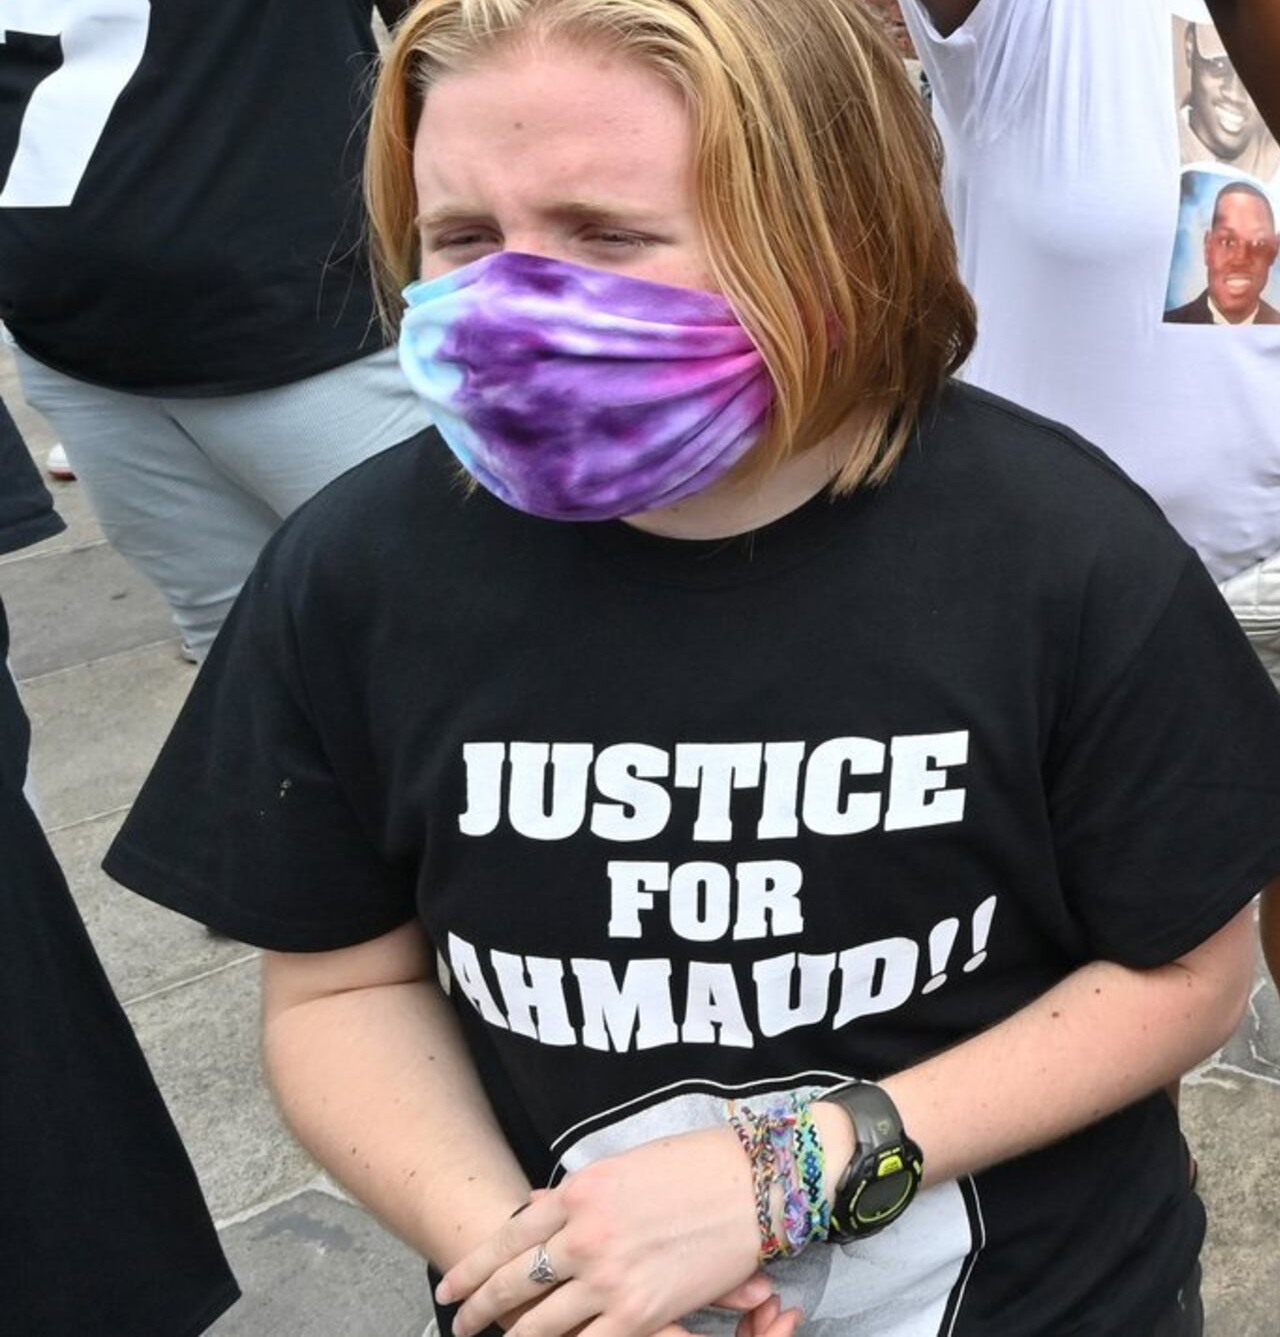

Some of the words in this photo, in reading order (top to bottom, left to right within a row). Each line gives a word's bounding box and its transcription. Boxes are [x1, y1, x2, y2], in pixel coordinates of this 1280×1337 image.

[458, 729, 970, 842] JUSTICE
[607, 860, 804, 941] FOR
[447, 894, 998, 1054] AHMAUD!!
